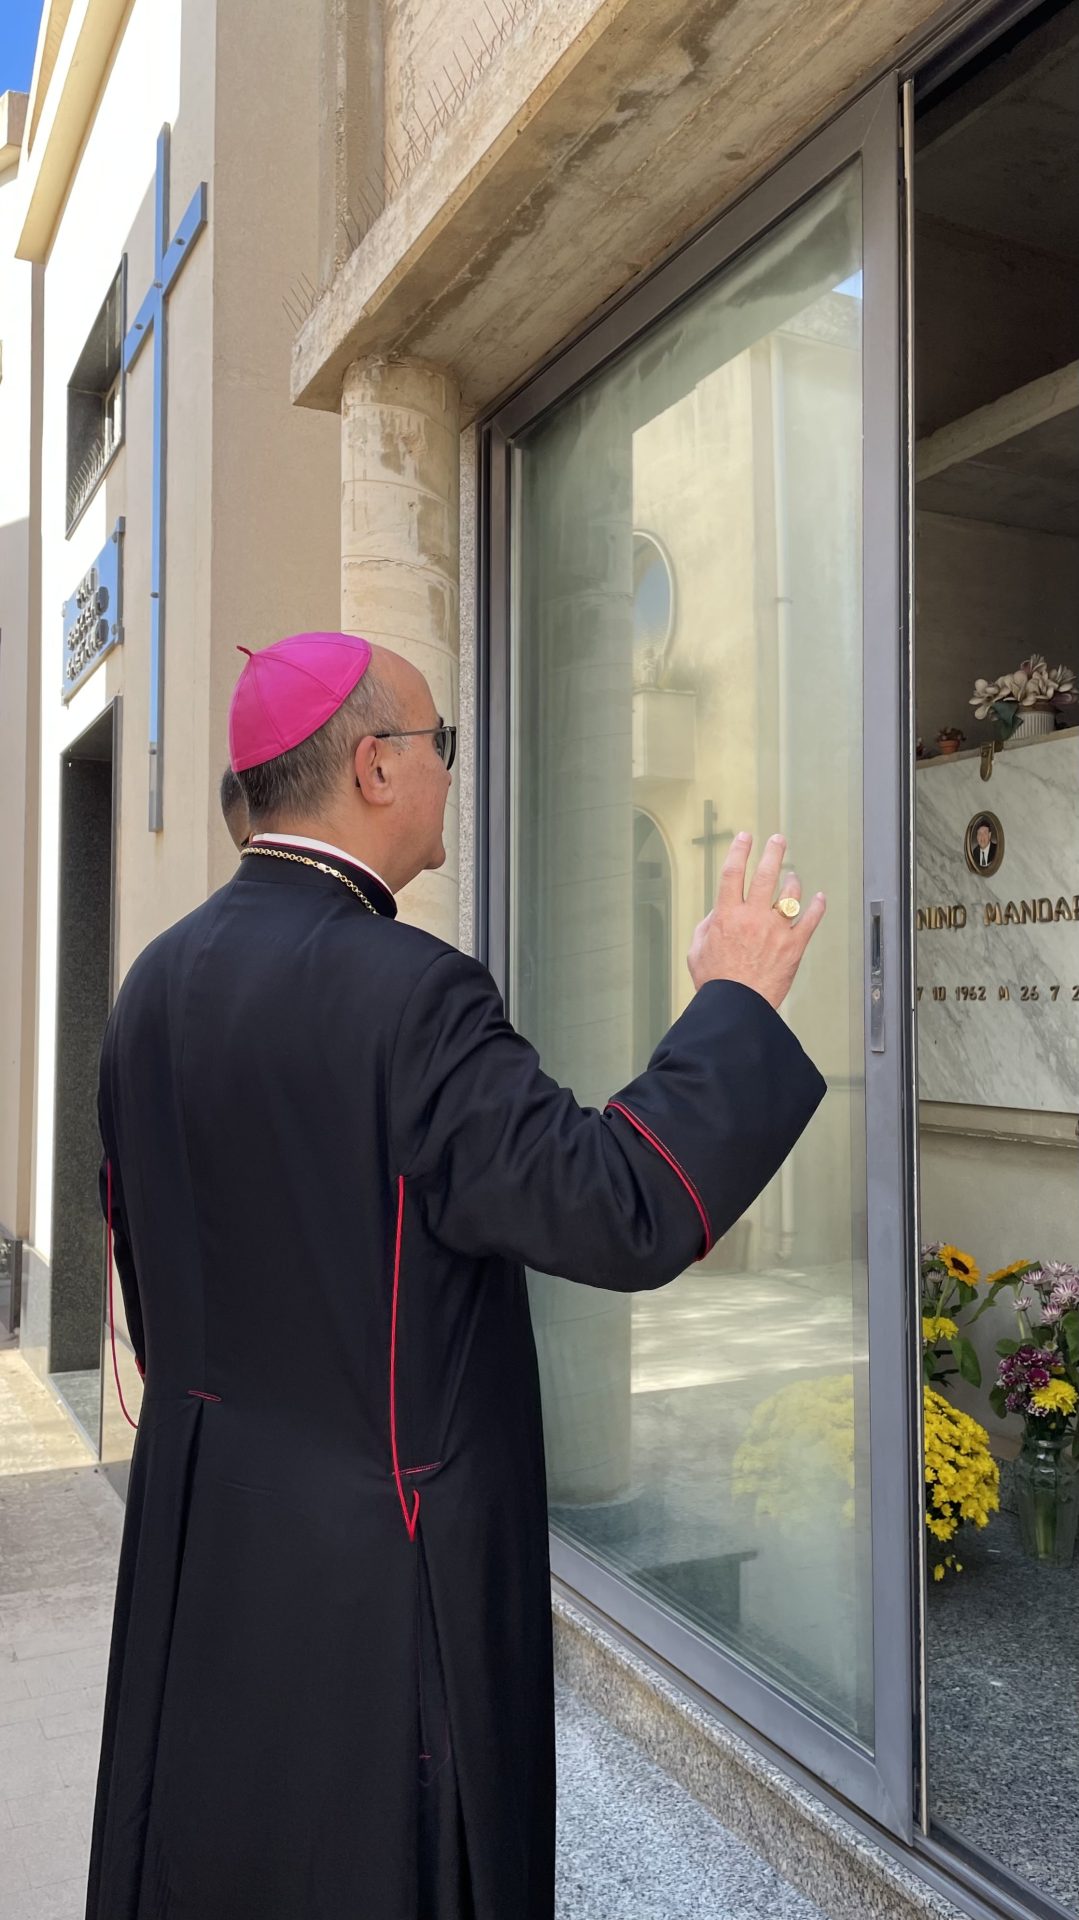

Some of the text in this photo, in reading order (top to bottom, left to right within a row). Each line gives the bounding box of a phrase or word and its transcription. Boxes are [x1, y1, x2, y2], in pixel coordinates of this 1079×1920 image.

[932, 986, 946, 1001] 10
[955, 986, 986, 1001] 1962
[1020, 986, 1040, 1001] 26
[1050, 985, 1060, 1001] 7
